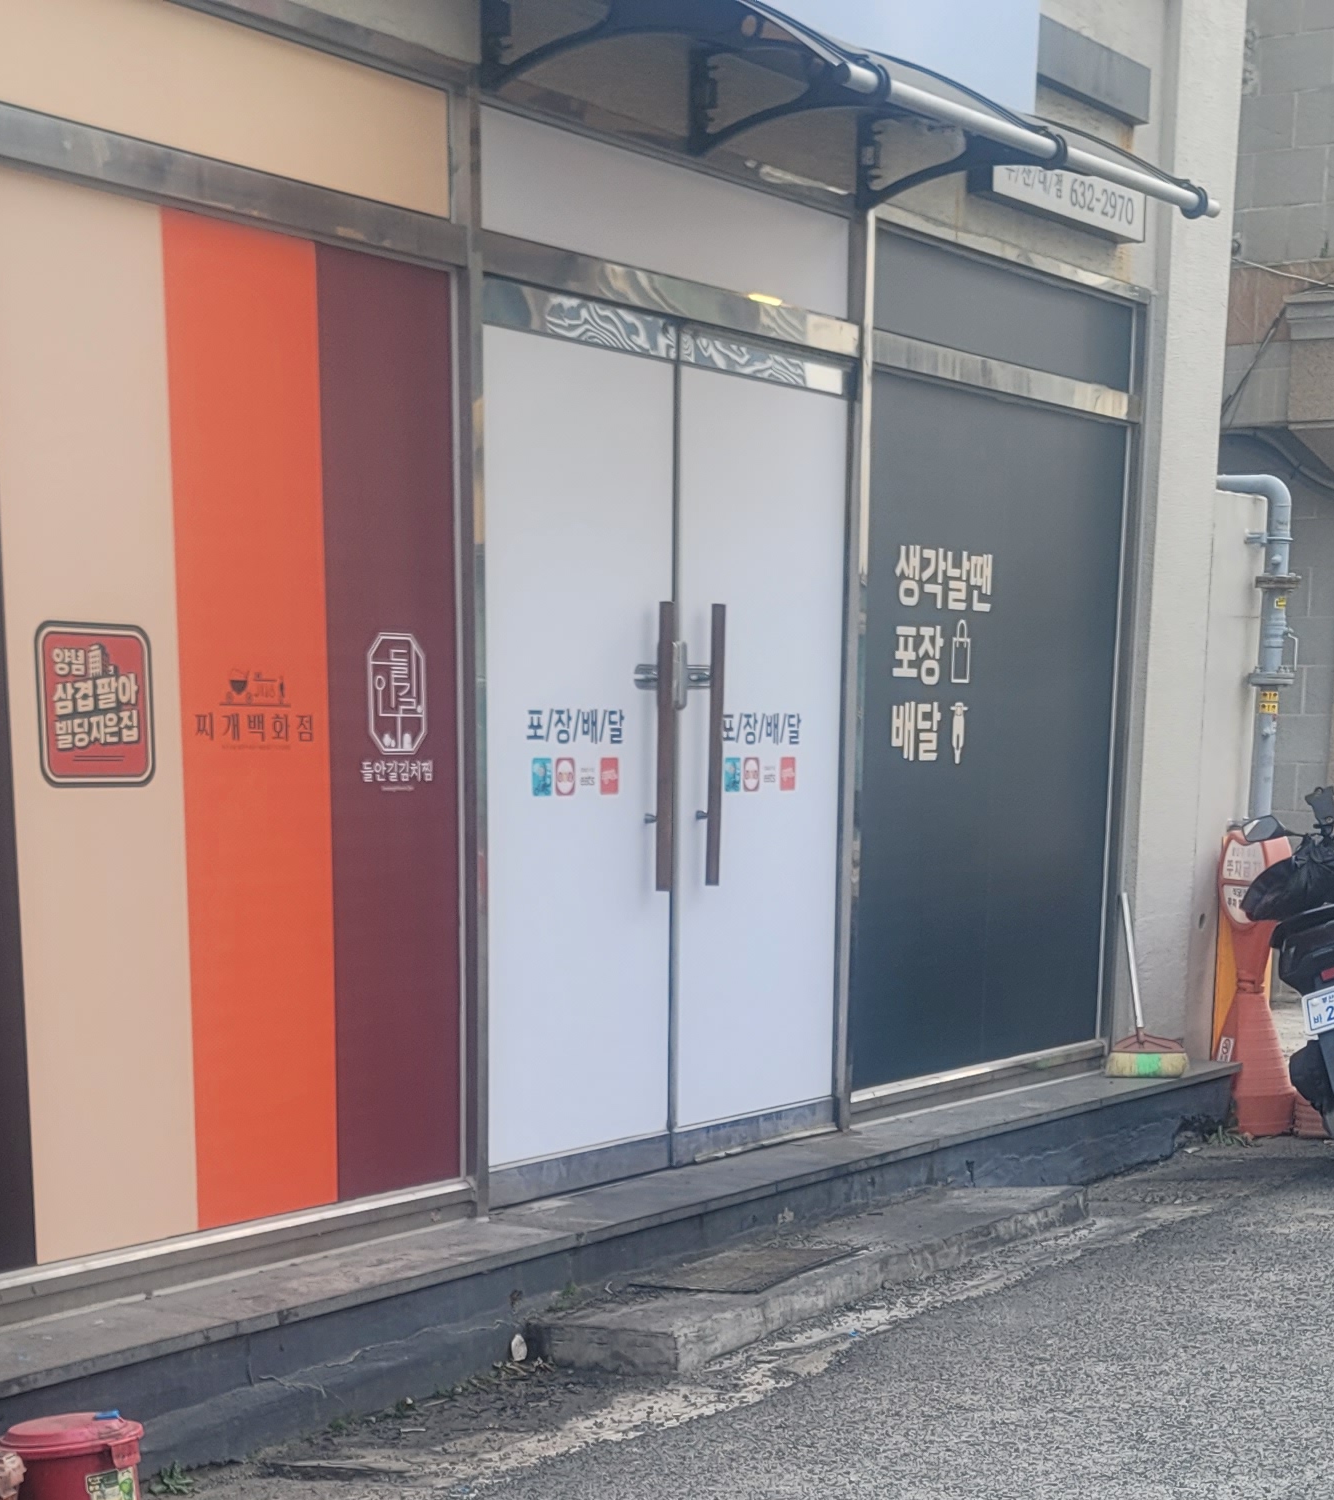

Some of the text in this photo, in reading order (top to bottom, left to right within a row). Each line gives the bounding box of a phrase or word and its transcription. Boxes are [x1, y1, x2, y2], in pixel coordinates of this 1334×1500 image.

[1070, 178, 1134, 225] 632-2970
[895, 544, 994, 612] 생각날땐
[52, 647, 85, 676] 양념
[892, 625, 944, 686] 포장
[194, 712, 314, 743] 찌개백화점
[891, 701, 941, 762] 배달
